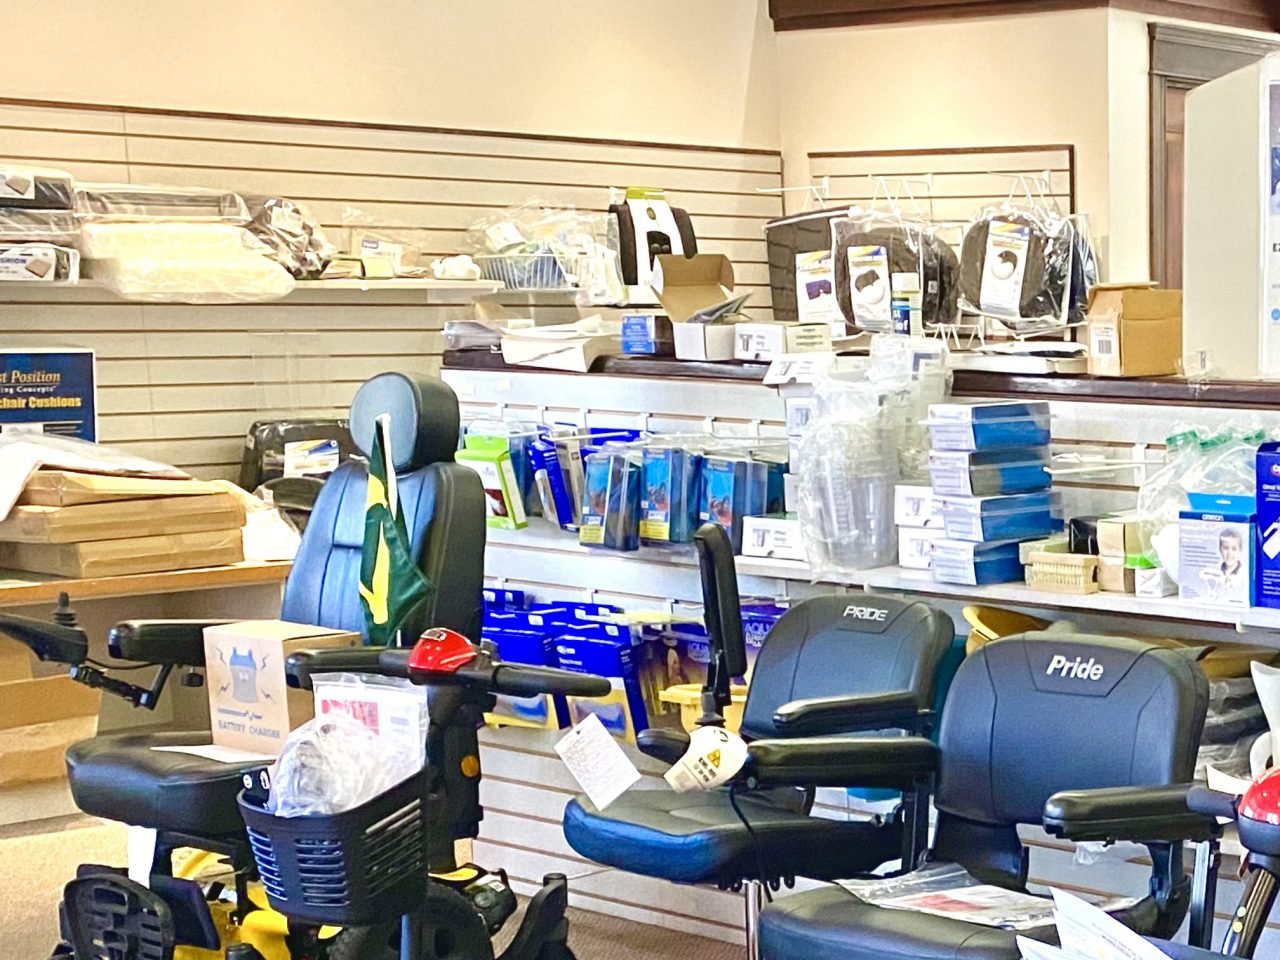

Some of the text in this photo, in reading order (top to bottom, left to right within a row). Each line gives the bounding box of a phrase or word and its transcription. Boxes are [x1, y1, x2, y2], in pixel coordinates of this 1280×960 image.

[11, 370, 60, 383] Position
[16, 385, 54, 394] Concepts
[29, 396, 82, 408] Cushions
[843, 605, 889, 622] PRIDE
[744, 622, 770, 635] AQU
[1046, 655, 1104, 681] Pride
[218, 720, 280, 739] BATTERY CHARGER
